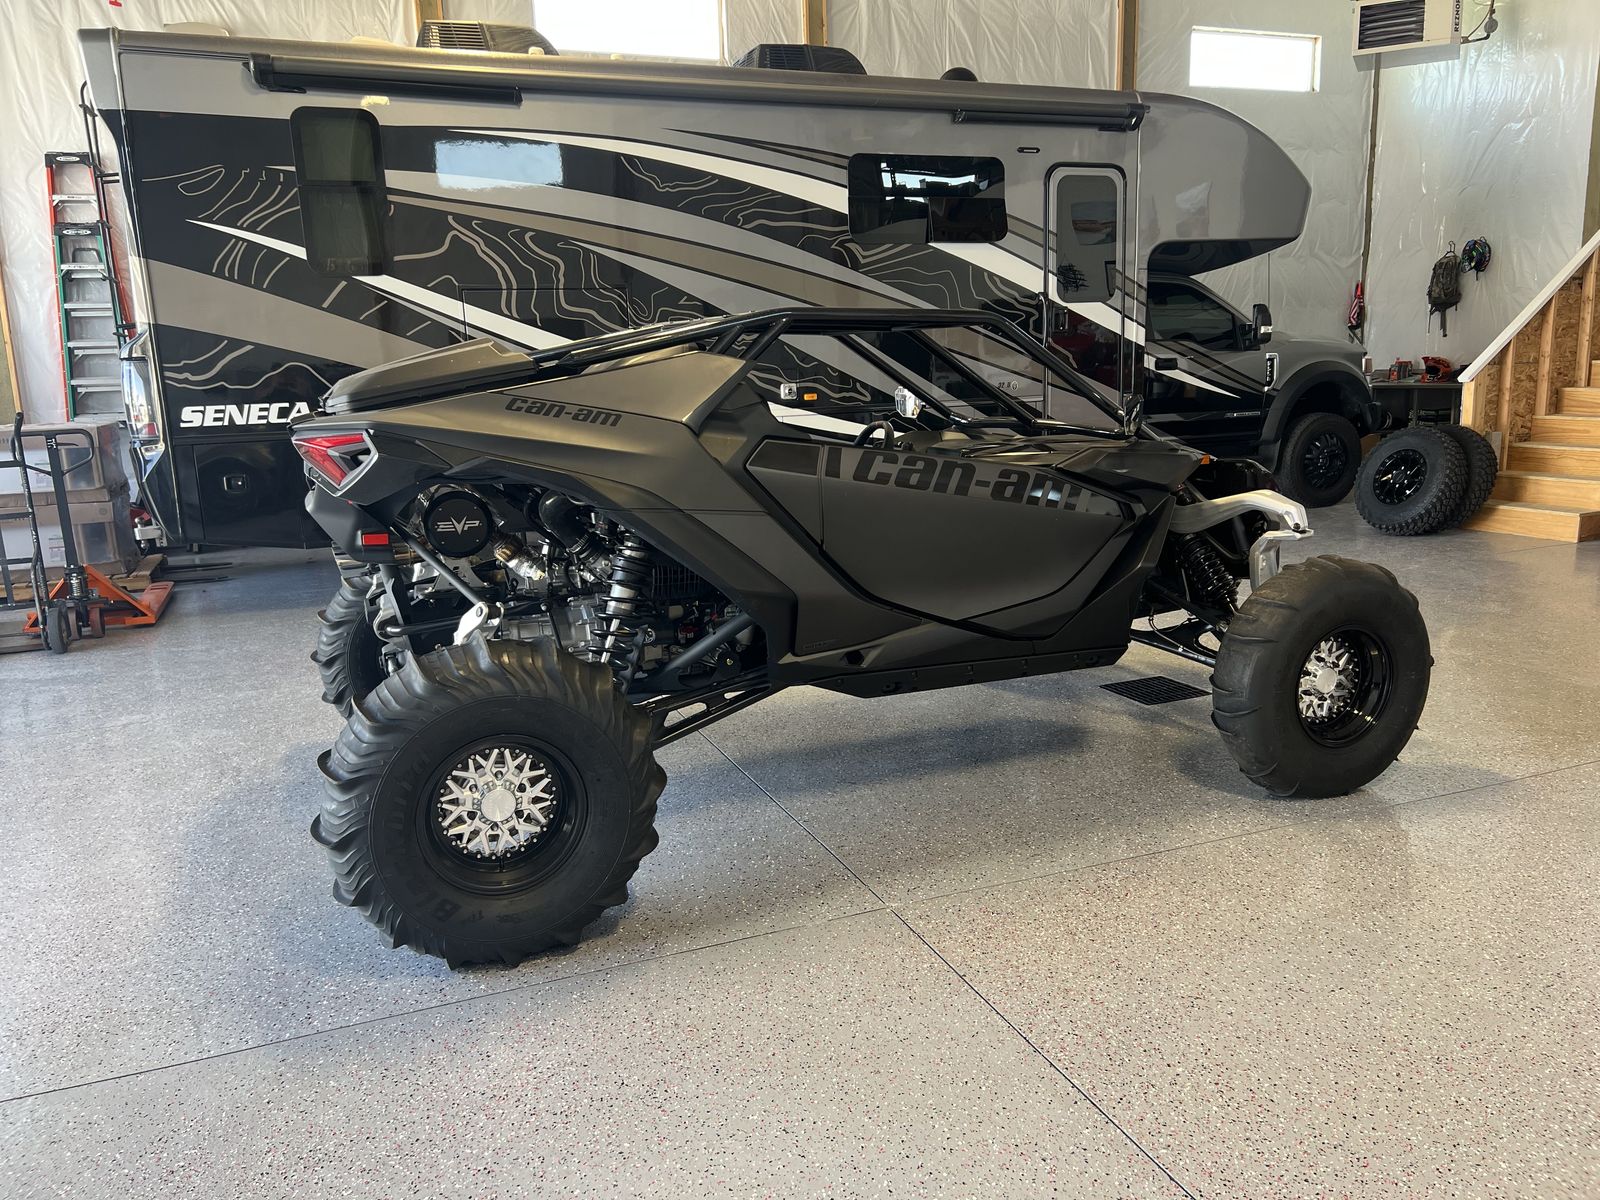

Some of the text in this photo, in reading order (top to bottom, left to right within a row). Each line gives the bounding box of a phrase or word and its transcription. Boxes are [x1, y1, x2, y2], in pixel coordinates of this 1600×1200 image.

[180, 402, 310, 428] SENECA
[505, 396, 623, 427] can-am
[852, 450, 1081, 510] can-am
[436, 515, 480, 535] EVP
